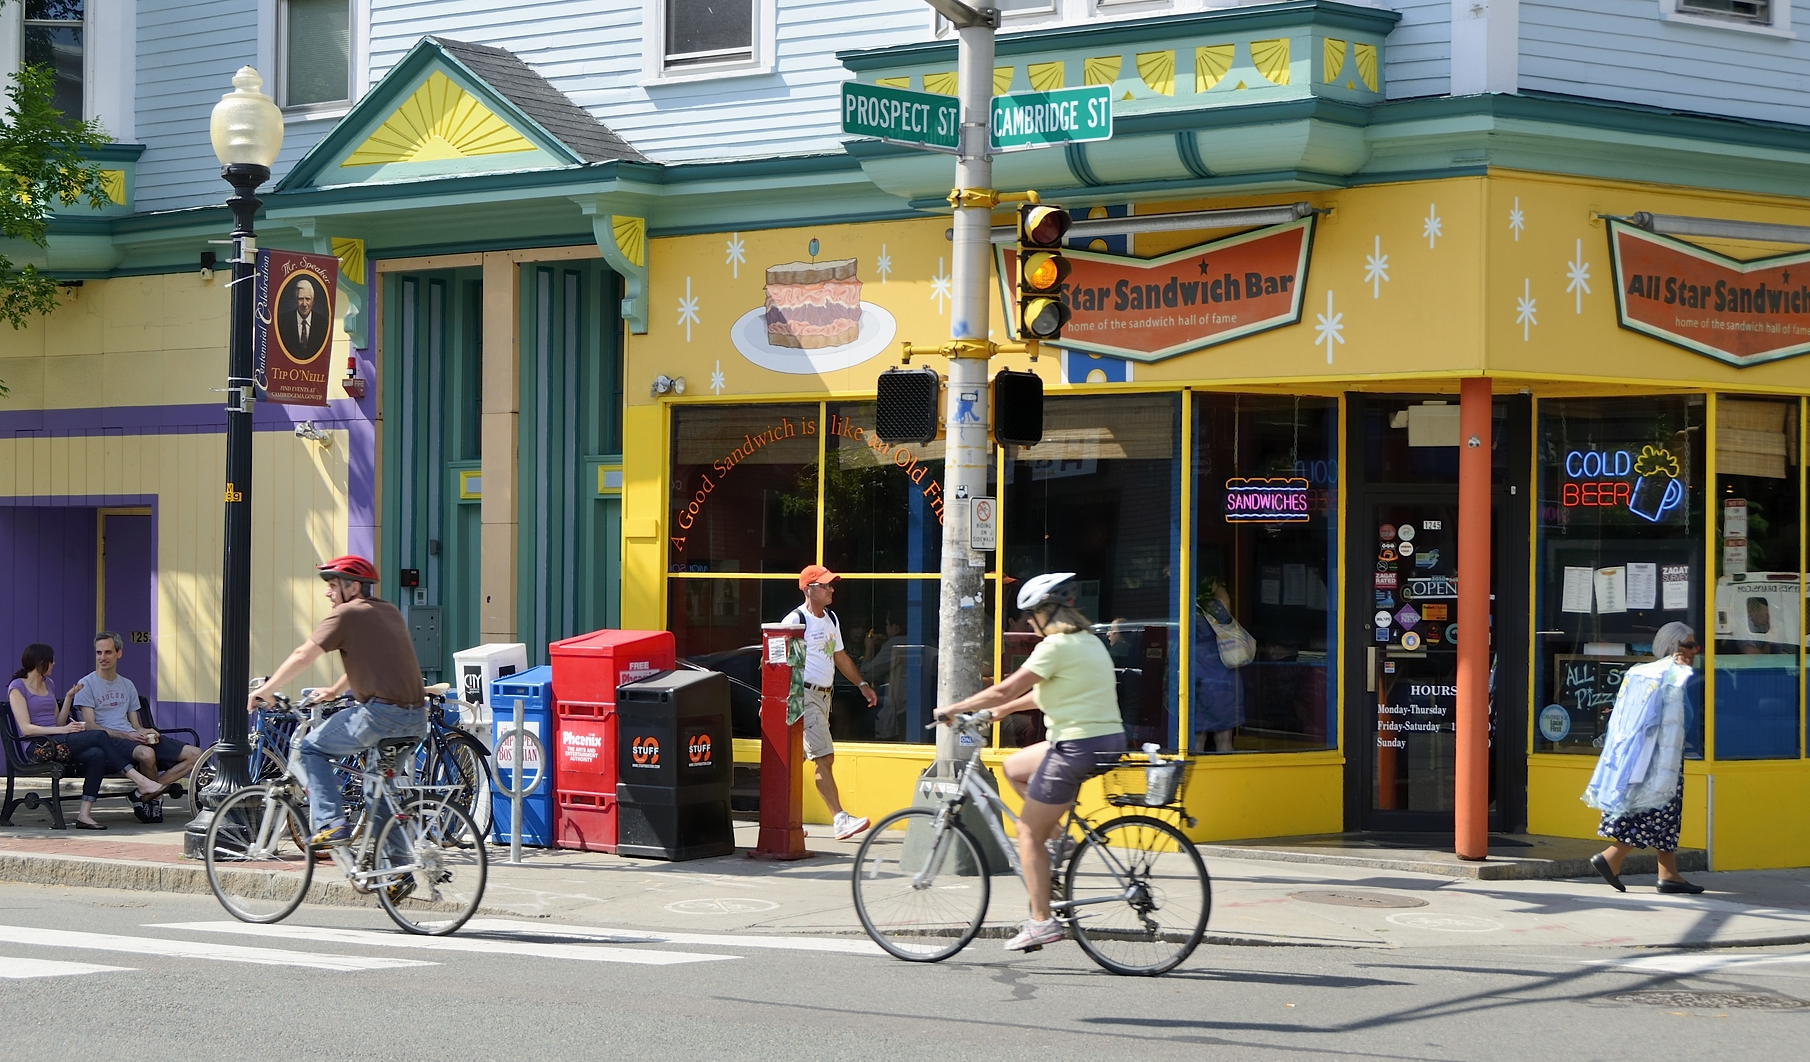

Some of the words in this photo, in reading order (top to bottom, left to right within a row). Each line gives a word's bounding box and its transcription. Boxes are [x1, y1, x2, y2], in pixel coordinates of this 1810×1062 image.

[846, 94, 930, 133] PROSPECT
[938, 106, 957, 137] ST
[993, 100, 1078, 138] CAMBRIDGE
[1088, 96, 1108, 128] ST
[281, 260, 298, 277] Mr.
[300, 256, 330, 284] Speaker
[256, 256, 272, 324] Celebration
[1061, 282, 1110, 312] Star
[1114, 271, 1241, 312] Sandwich
[1244, 272, 1294, 299] Bar
[1627, 274, 1660, 300] All
[1664, 276, 1711, 310] Star
[1714, 279, 1810, 314] Sandwich
[1068, 321, 1095, 332] home
[1098, 318, 1108, 330] of
[1110, 318, 1126, 330] the
[1128, 316, 1175, 329] sandwich
[1178, 315, 1196, 326] hall
[1199, 314, 1210, 325] of
[1212, 313, 1237, 324] fame
[1675, 316, 1698, 328] home
[1701, 317, 1710, 328] of
[1711, 318, 1724, 330] the
[1726, 320, 1764, 332] sandwich
[1766, 322, 1781, 334] hall
[1782, 323, 1791, 334] of
[1792, 324, 1810, 336] fame
[254, 324, 268, 392] Centennial
[271, 368, 288, 380] TIP
[290, 368, 326, 382] O'NEILL
[801, 416, 816, 435] is
[830, 414, 864, 442] like
[713, 417, 796, 479] Sandwich
[868, 434, 890, 455] an
[894, 447, 928, 486] Old
[1566, 450, 1630, 478] COLD
[678, 474, 715, 531] Good
[1227, 493, 1308, 511] SANDWICHES
[1562, 482, 1630, 507] BEER
[1424, 520, 1442, 530] 1245
[671, 536, 686, 552] A
[1662, 566, 1689, 574] ZAGAT
[1662, 574, 1689, 582] SURVEY
[1412, 582, 1457, 595] OPEN
[629, 662, 649, 670] FREE
[1566, 664, 1595, 687] ALL
[464, 674, 482, 688] CITY
[1411, 685, 1457, 696] HOURS
[1574, 687, 1619, 710] Pizz
[1377, 704, 1447, 716] Monday-Thursday
[1377, 721, 1440, 733] Friday-Saturday
[632, 746, 659, 755] STUFF
[689, 744, 711, 753] STUFF
[1377, 737, 1406, 749] Sunday
